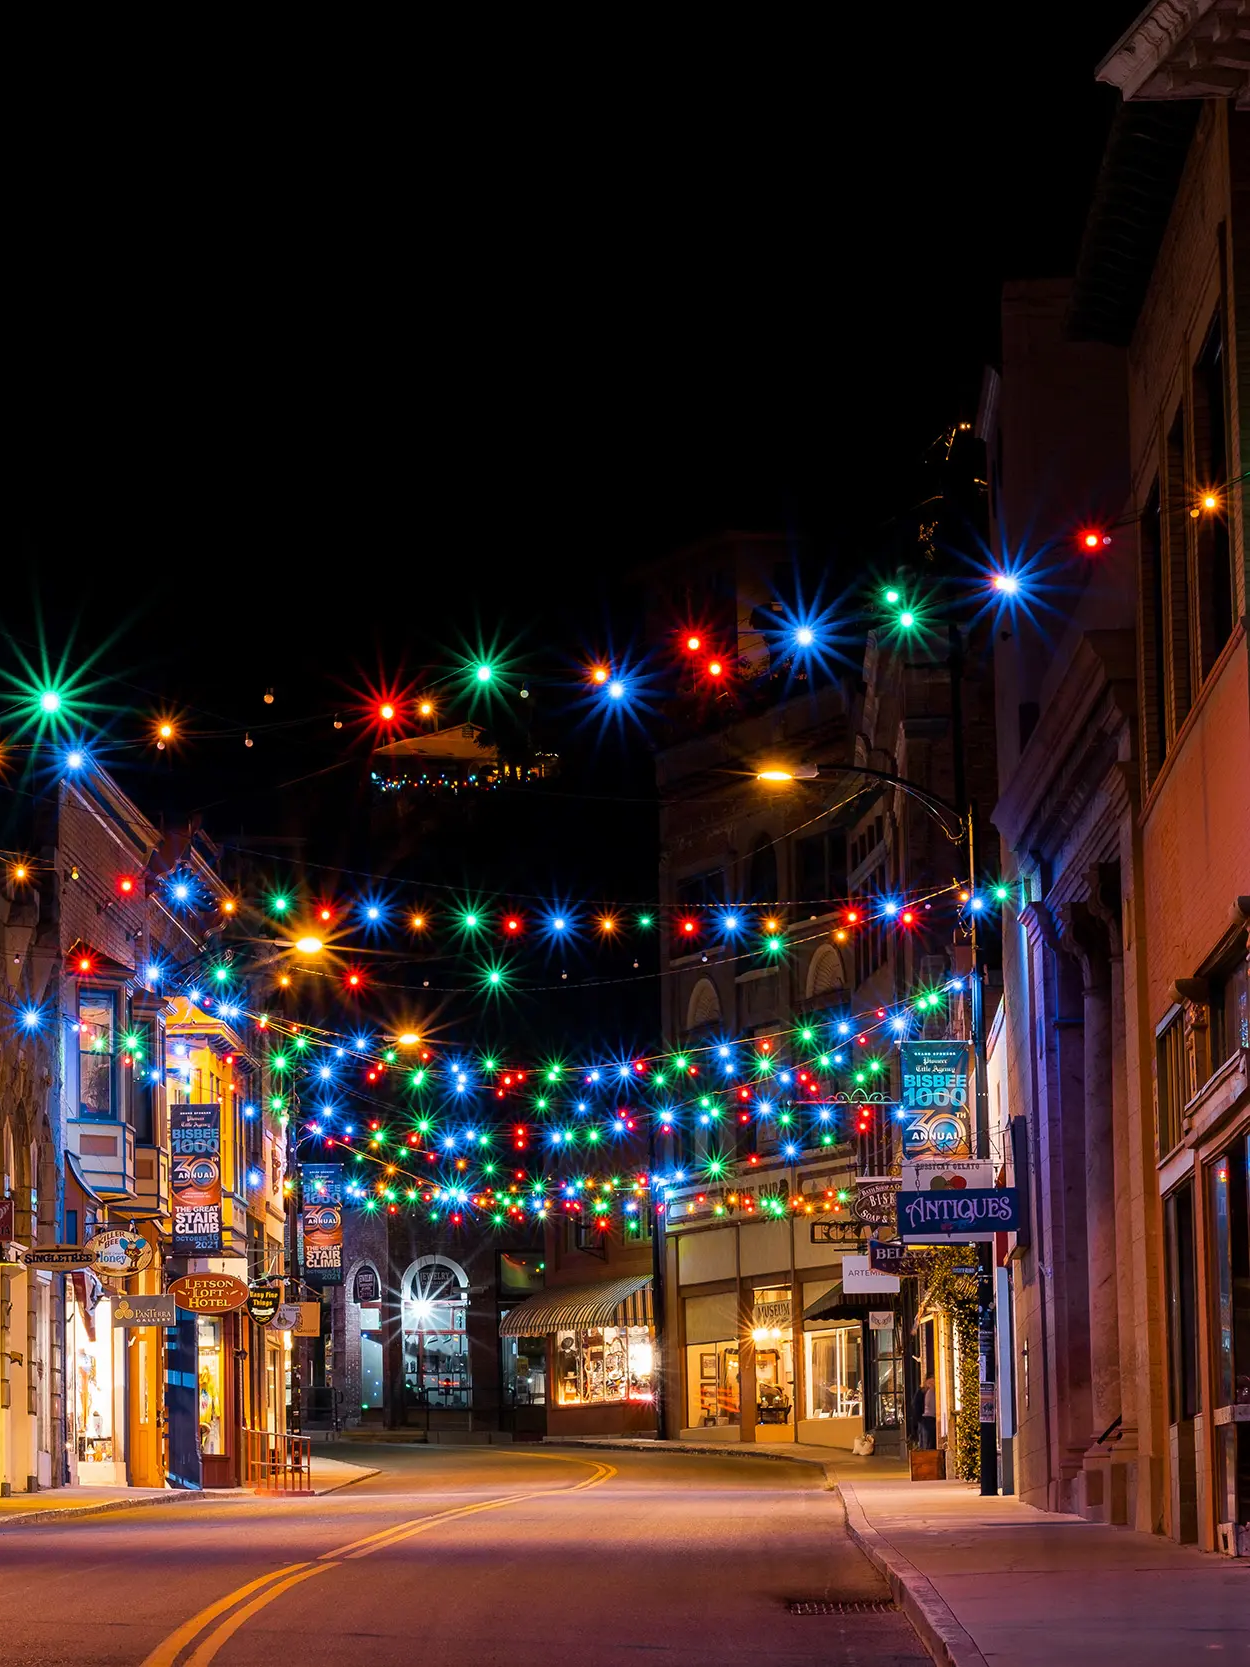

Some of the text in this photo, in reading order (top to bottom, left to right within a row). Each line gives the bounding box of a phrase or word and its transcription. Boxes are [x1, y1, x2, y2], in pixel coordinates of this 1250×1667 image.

[904, 1074, 966, 1088] BISBEE
[903, 1088, 966, 1106] 1000
[172, 1128, 219, 1138] BISBEE
[912, 1132, 960, 1140] ANNUAL
[172, 1139, 219, 1153] 1000
[175, 1212, 219, 1224] STAIR
[860, 1208, 880, 1222] SOAP
[906, 1197, 1012, 1228] ANTIQUES
[175, 1223, 220, 1234] CLIMB
[98, 1231, 126, 1247] KILLER
[104, 1238, 119, 1249] BEE
[24, 1252, 92, 1264] SINGLETREE
[96, 1250, 127, 1265] Honey
[306, 1250, 341, 1260] STAIR
[306, 1260, 342, 1268] CLIMB
[420, 1272, 450, 1282] JEWELRY
[185, 1278, 234, 1289] LETSON
[192, 1288, 225, 1298] LOFT
[188, 1298, 232, 1308] HOTEL
[758, 1303, 790, 1318] MUSEUM
